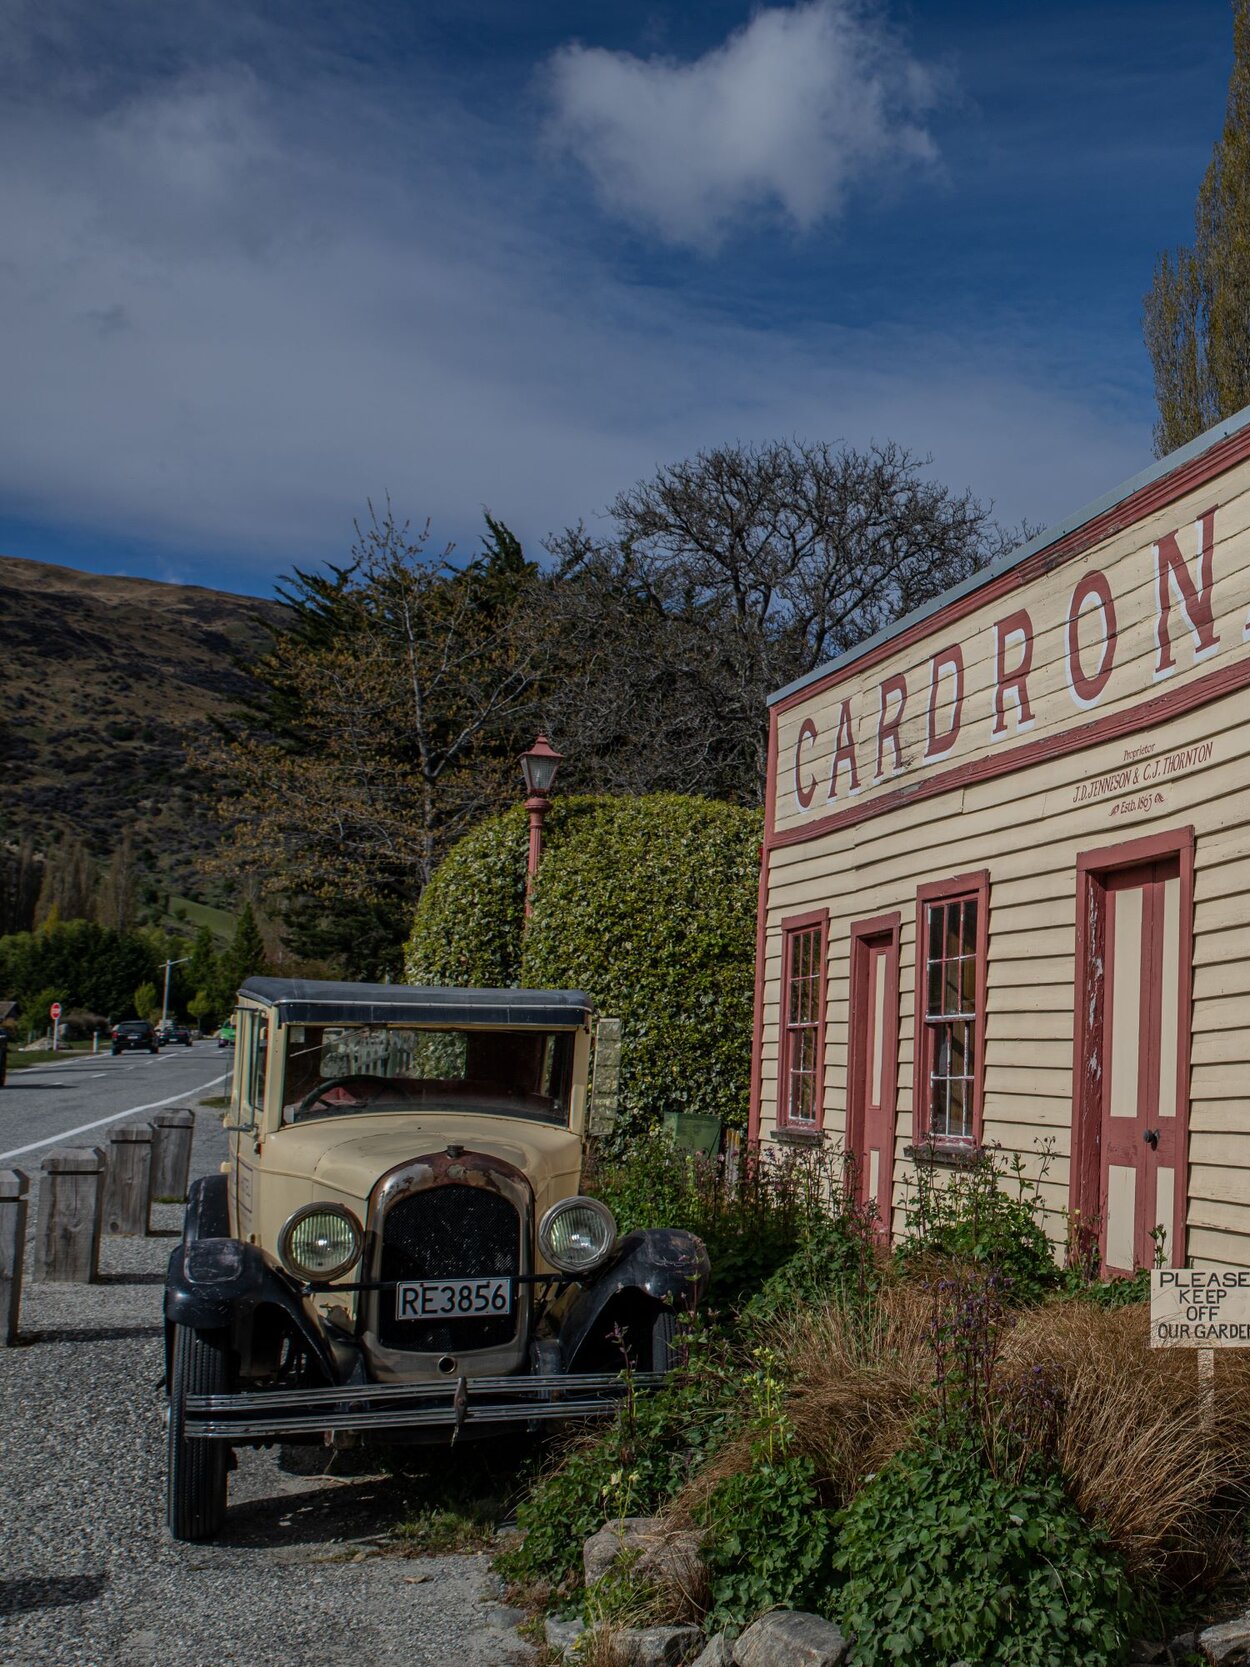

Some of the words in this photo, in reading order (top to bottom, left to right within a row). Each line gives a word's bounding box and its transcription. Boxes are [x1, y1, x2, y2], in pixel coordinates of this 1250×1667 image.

[1123, 743, 1156, 761] Proprietor
[1132, 767, 1139, 784] &
[1162, 742, 1214, 775] THORNTON
[1160, 1271, 1250, 1288] PLEASE
[401, 1283, 507, 1317] RE3856
[1179, 1289, 1227, 1304] KEEP
[1186, 1305, 1220, 1321] OFF
[1158, 1323, 1190, 1339] OUR
